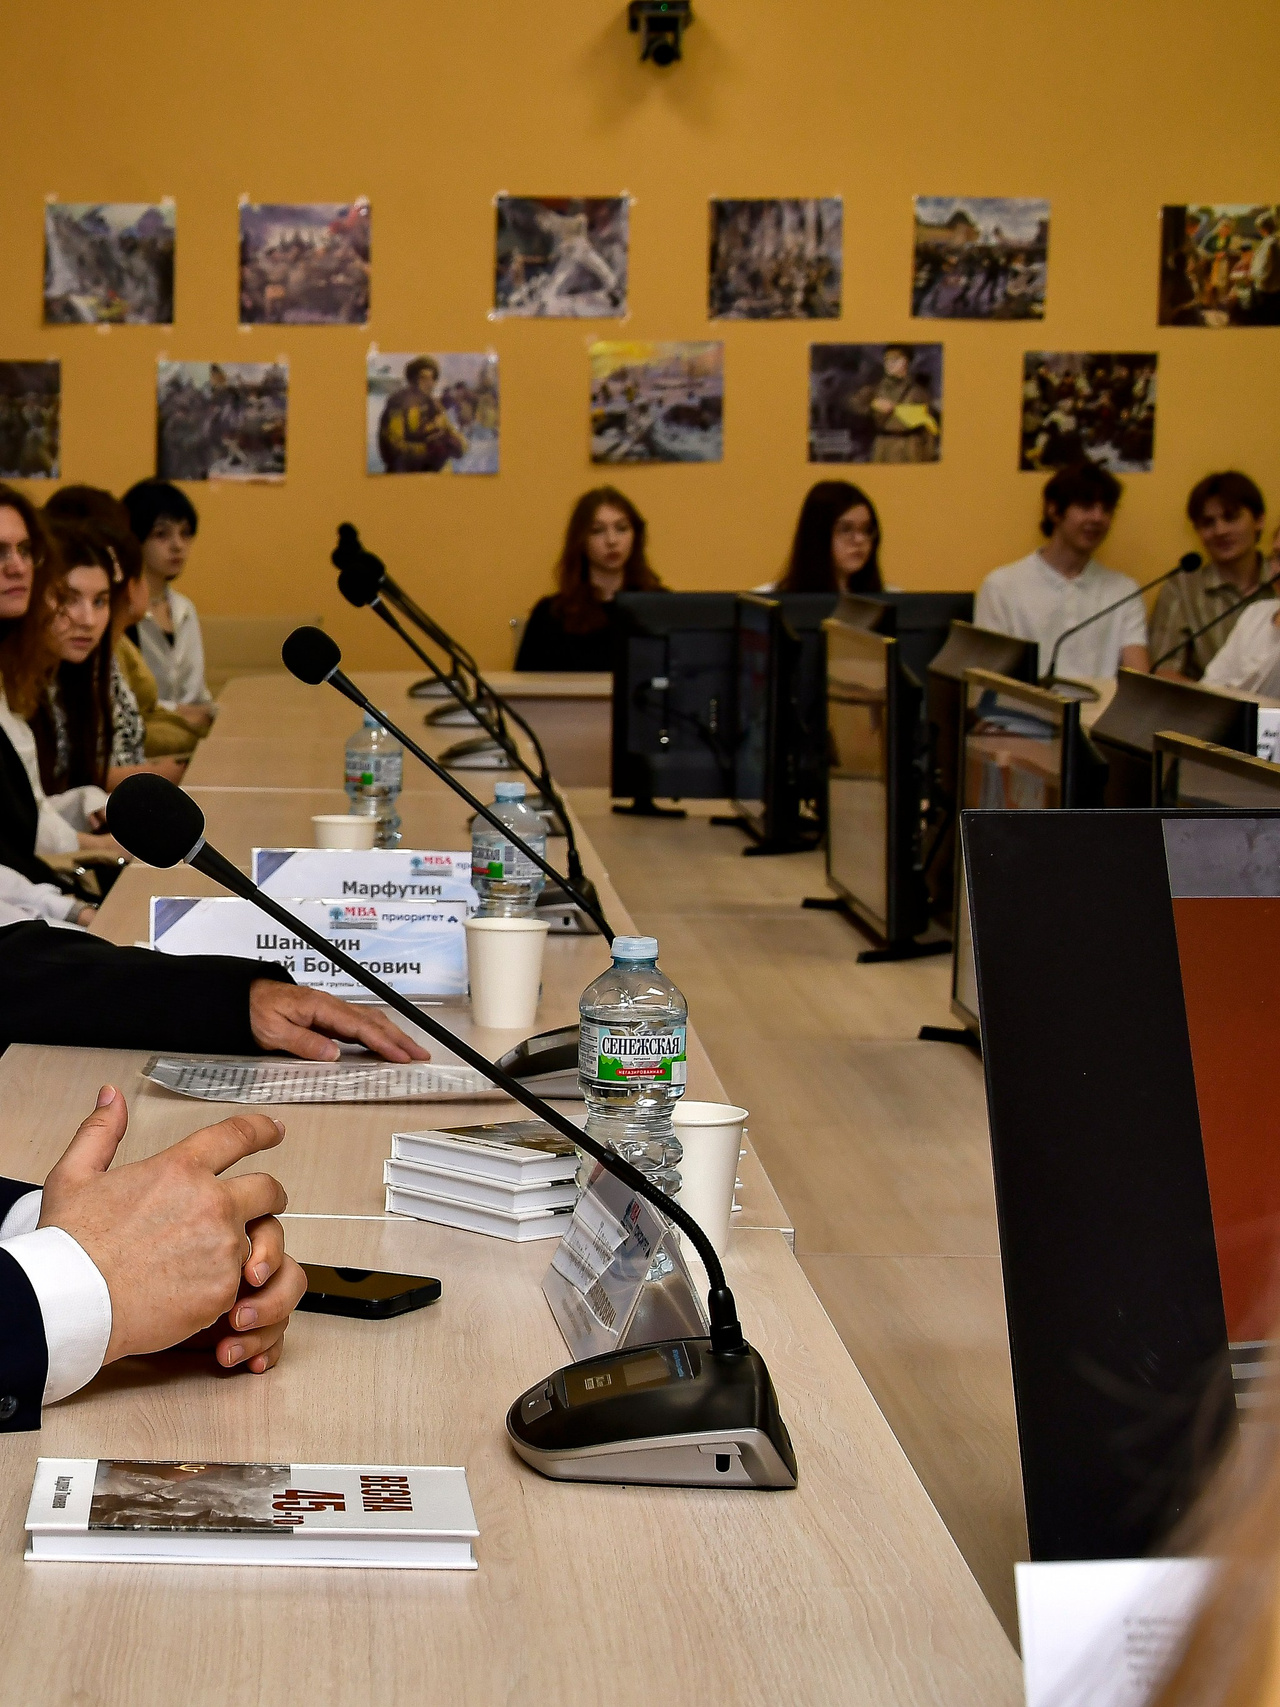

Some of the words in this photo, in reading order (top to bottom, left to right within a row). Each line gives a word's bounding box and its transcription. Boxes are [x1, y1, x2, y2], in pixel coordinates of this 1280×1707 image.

[342, 881, 443, 900] Марфутин
[381, 912, 445, 923] приоритет
[304, 958, 422, 975] Борсович
[601, 1036, 680, 1056] СЕНЕЖСКАЯ
[359, 1475, 413, 1512] ВЕСНА
